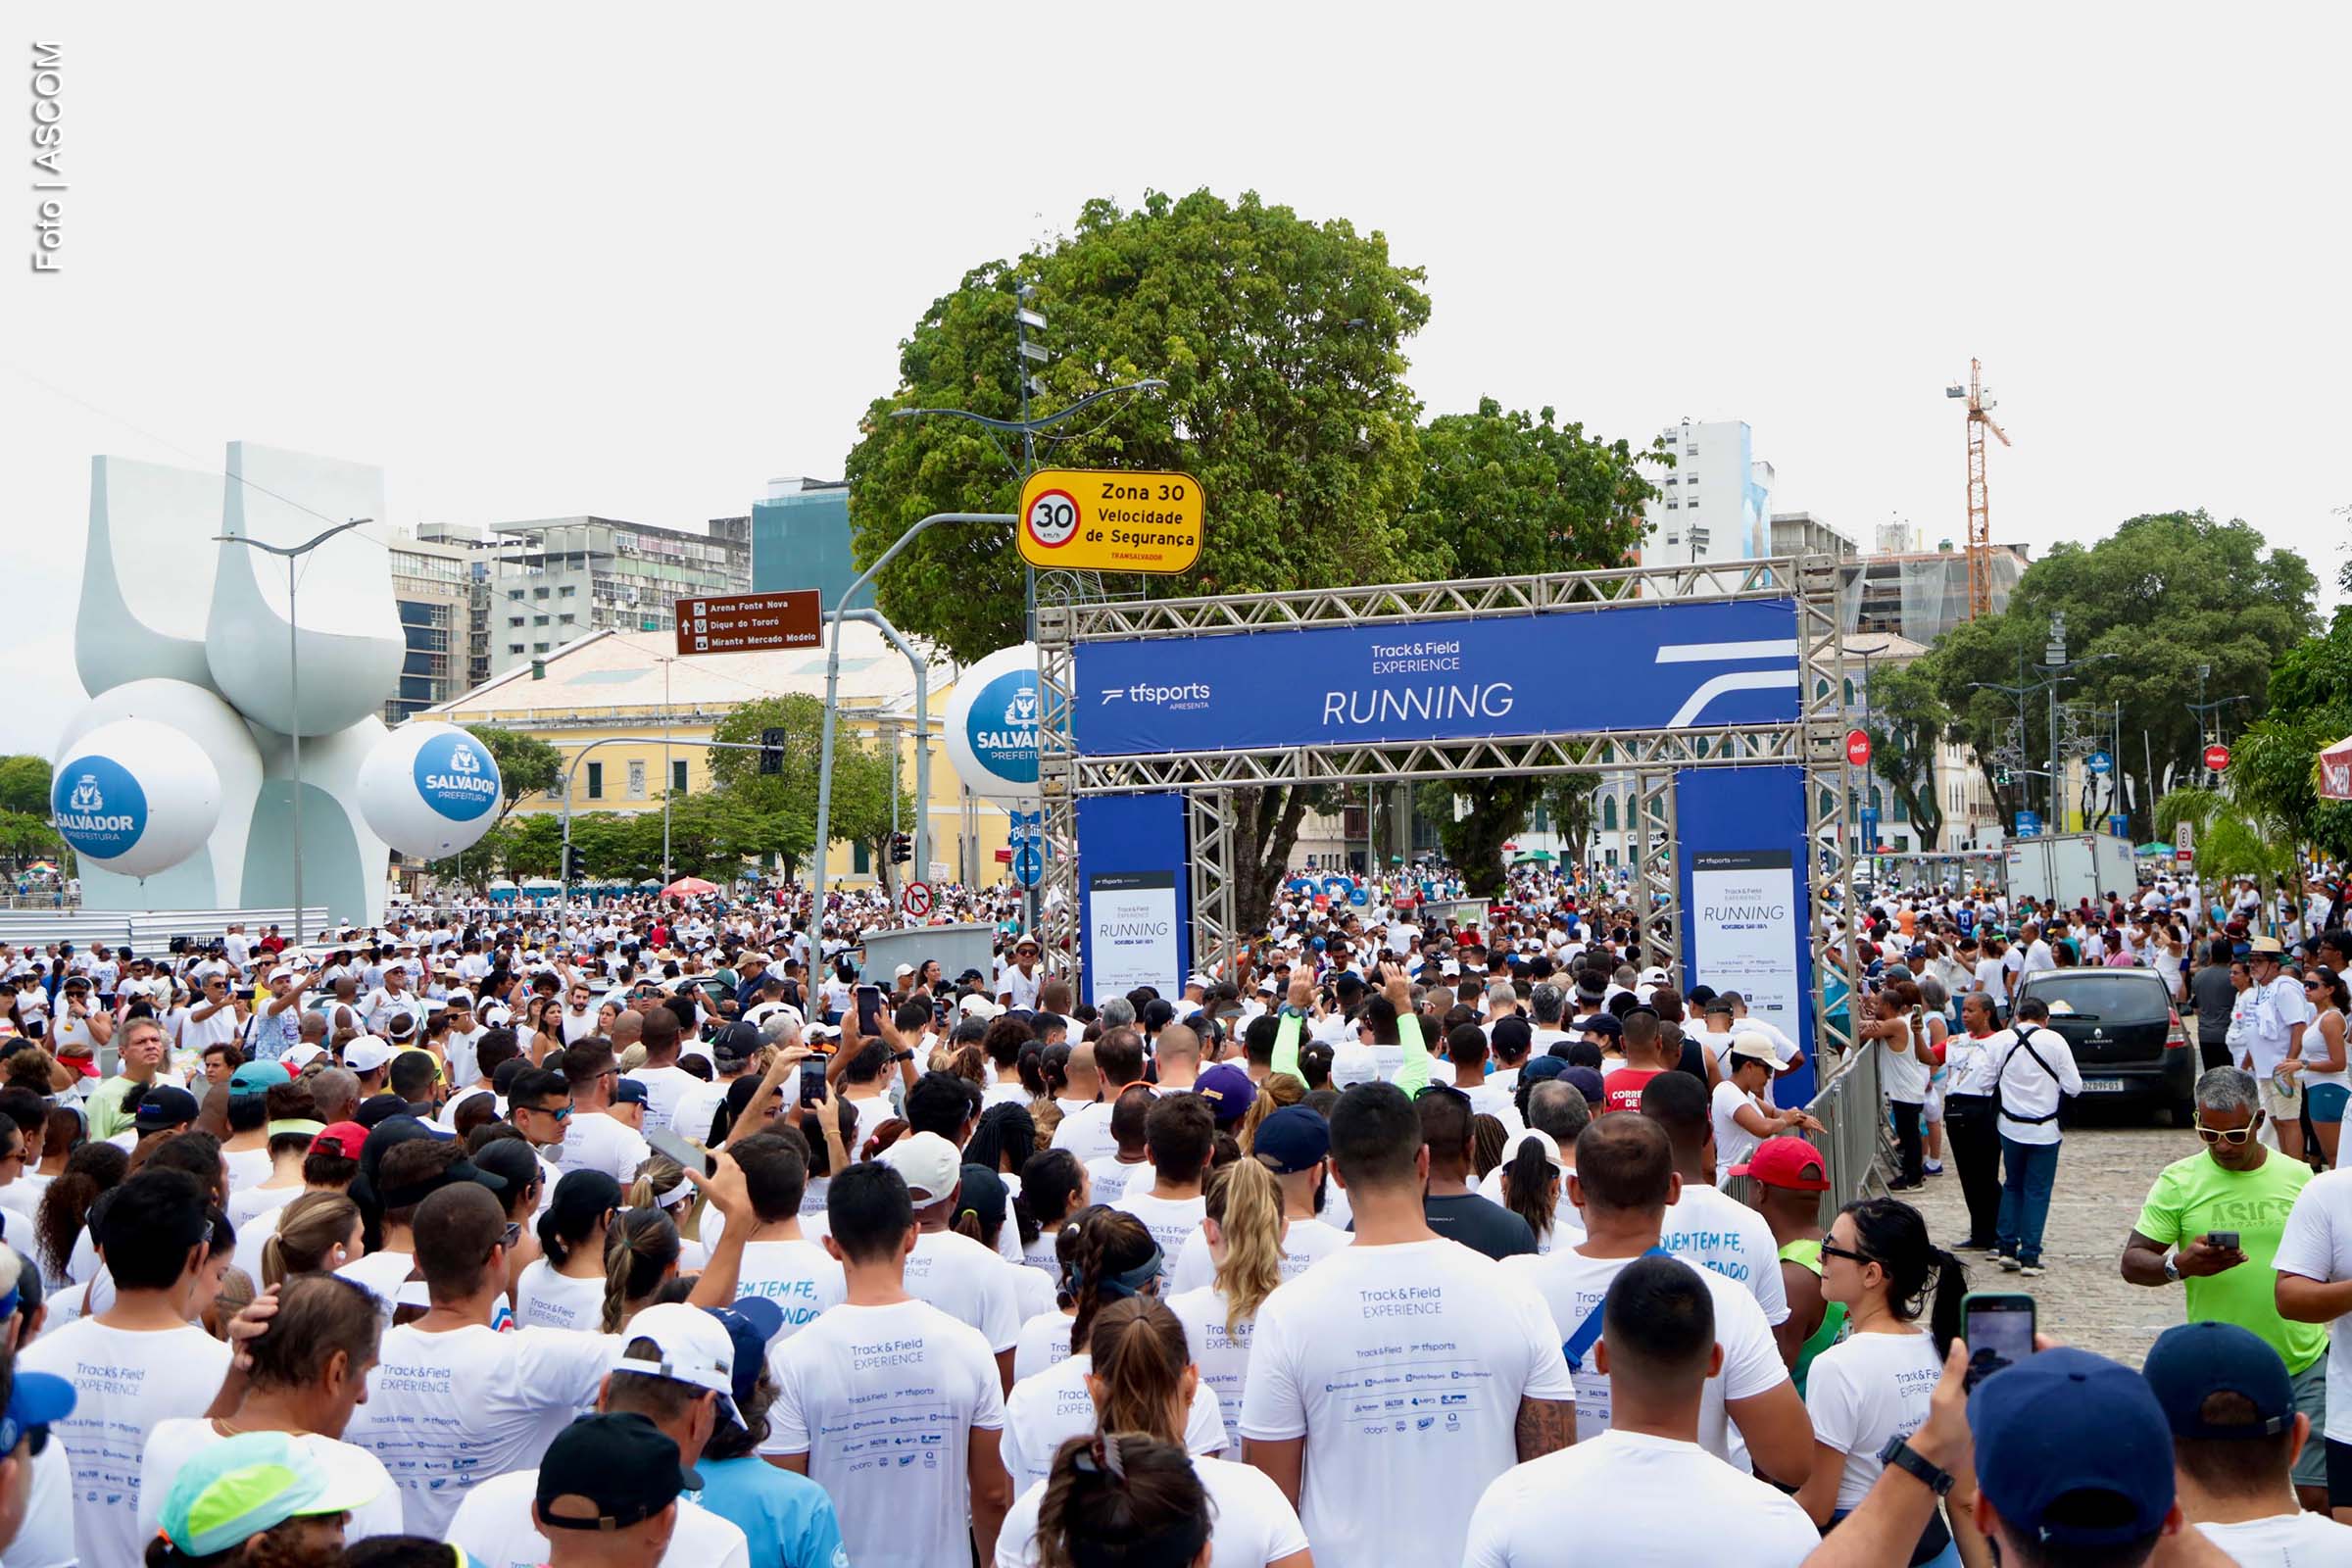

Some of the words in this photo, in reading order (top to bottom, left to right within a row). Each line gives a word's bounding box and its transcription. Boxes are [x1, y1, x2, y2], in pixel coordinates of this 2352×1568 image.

[1101, 483, 1150, 501] Zona
[1158, 485, 1185, 501] 30
[1035, 503, 1074, 528] 30
[1098, 508, 1183, 524] Velocidade
[1086, 529, 1103, 542] de
[1110, 530, 1195, 548] Segurança
[1111, 552, 1163, 562] TRANSALVADOR
[710, 604, 736, 612] Arena
[739, 602, 763, 611] Fonte
[767, 600, 788, 609] Nova
[710, 620, 734, 630] Dique
[751, 615, 779, 626] Tororó
[711, 637, 744, 647] Mirante
[748, 635, 783, 645] Mercado
[786, 633, 816, 642] Modelo
[1373, 658, 1460, 674] EXPERIENCE
[1129, 683, 1210, 705] tfsports
[1169, 702, 1209, 710] APRESENTA
[1323, 682, 1514, 725] RUNNING
[991, 751, 1040, 760] PREFEITU
[425, 774, 496, 796] SALVADOR
[438, 791, 487, 802] PREFEITURA
[57, 811, 134, 831] SALVADOR
[67, 830, 121, 841] PREFEITURA
[1704, 906, 1785, 921] RUNNING
[1100, 921, 1168, 938] RUNNING
[1612, 1090, 1643, 1100] CORRE
[1625, 1099, 1638, 1107] DE
[1690, 1231, 1720, 1251] TEM
[760, 1280, 791, 1298] TEM
[1363, 1302, 1443, 1319] EXPERIENCE
[1206, 1339, 1253, 1349] EXPERIE
[1421, 1342, 1456, 1352] tfsports
[854, 1351, 924, 1371] EXPERIENCE
[380, 1379, 451, 1394] EXPERIENCE
[905, 1388, 934, 1396] tfsports
[1056, 1403, 1093, 1416] EXPER
[1385, 1399, 1404, 1408] SALTUR
[431, 1416, 461, 1427] tfsports
